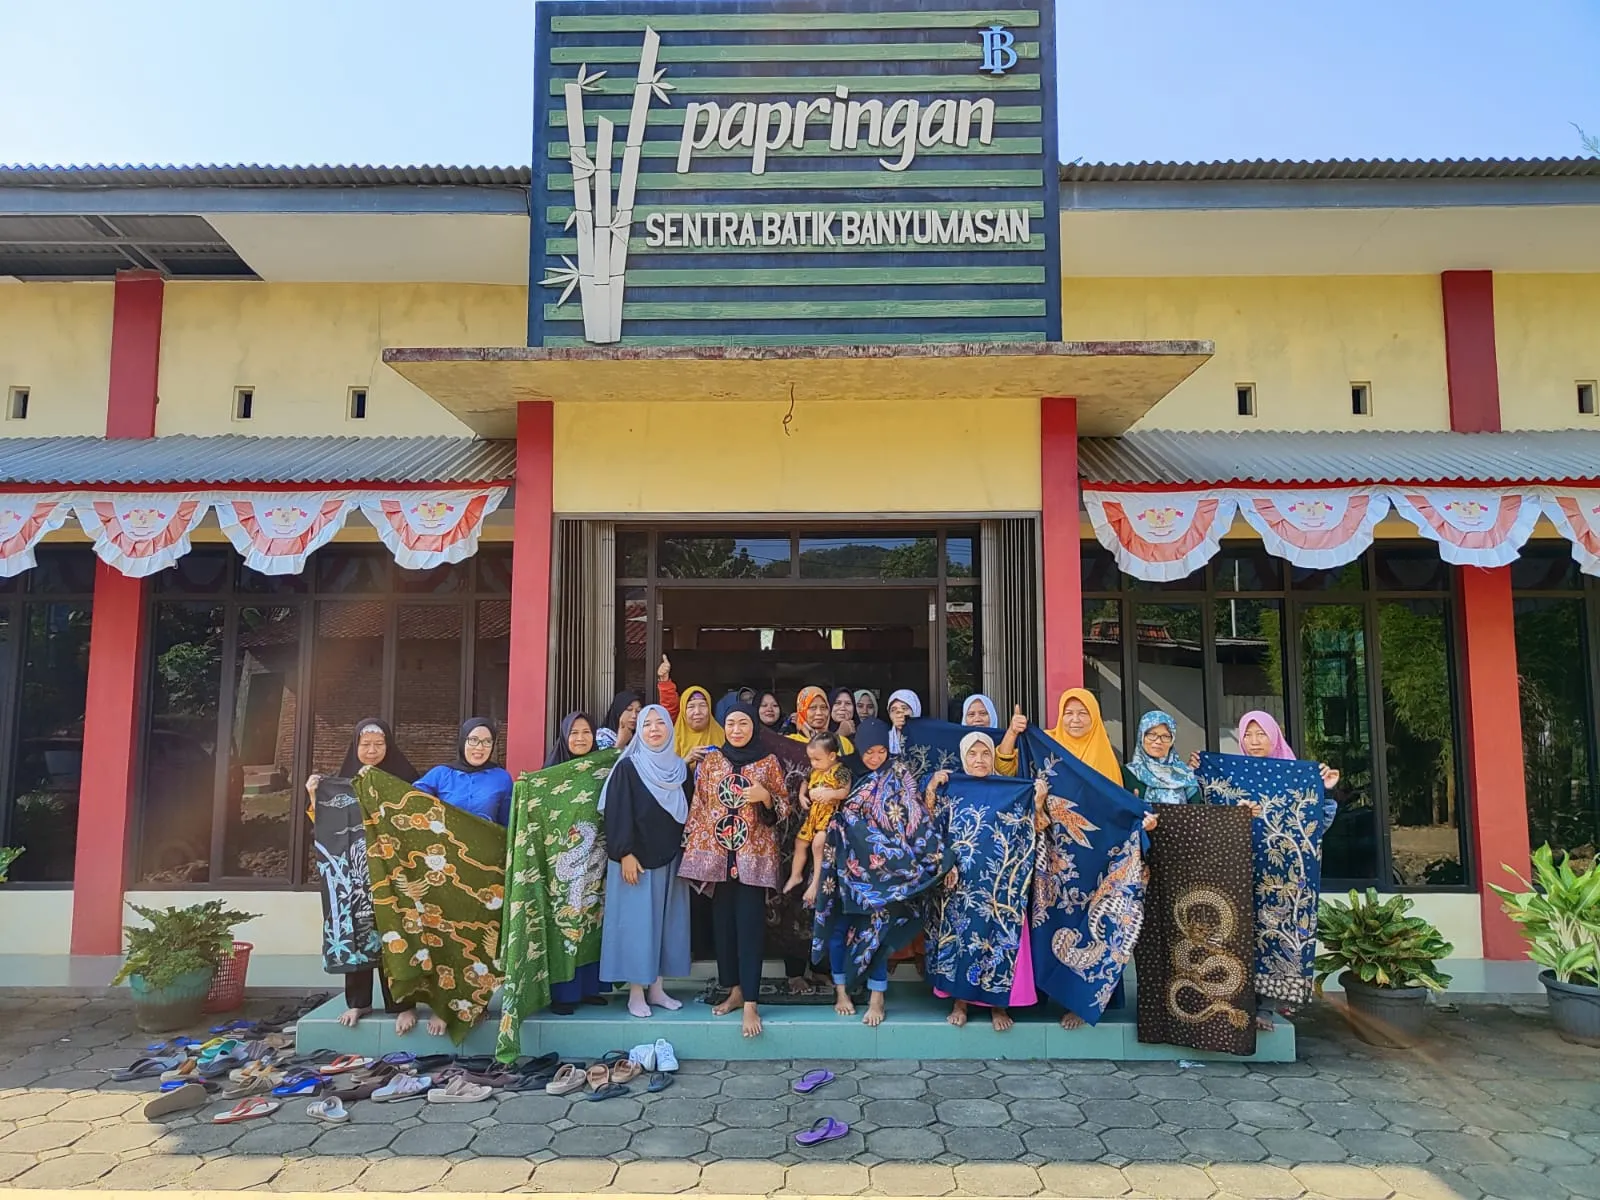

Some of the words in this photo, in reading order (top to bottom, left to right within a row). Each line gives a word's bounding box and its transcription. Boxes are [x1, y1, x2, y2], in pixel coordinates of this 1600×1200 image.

[676, 85, 995, 175] papringan
[645, 212, 758, 247] SENTRA
[762, 211, 837, 246] BATIK
[841, 208, 1031, 245] BANYUMASAN
